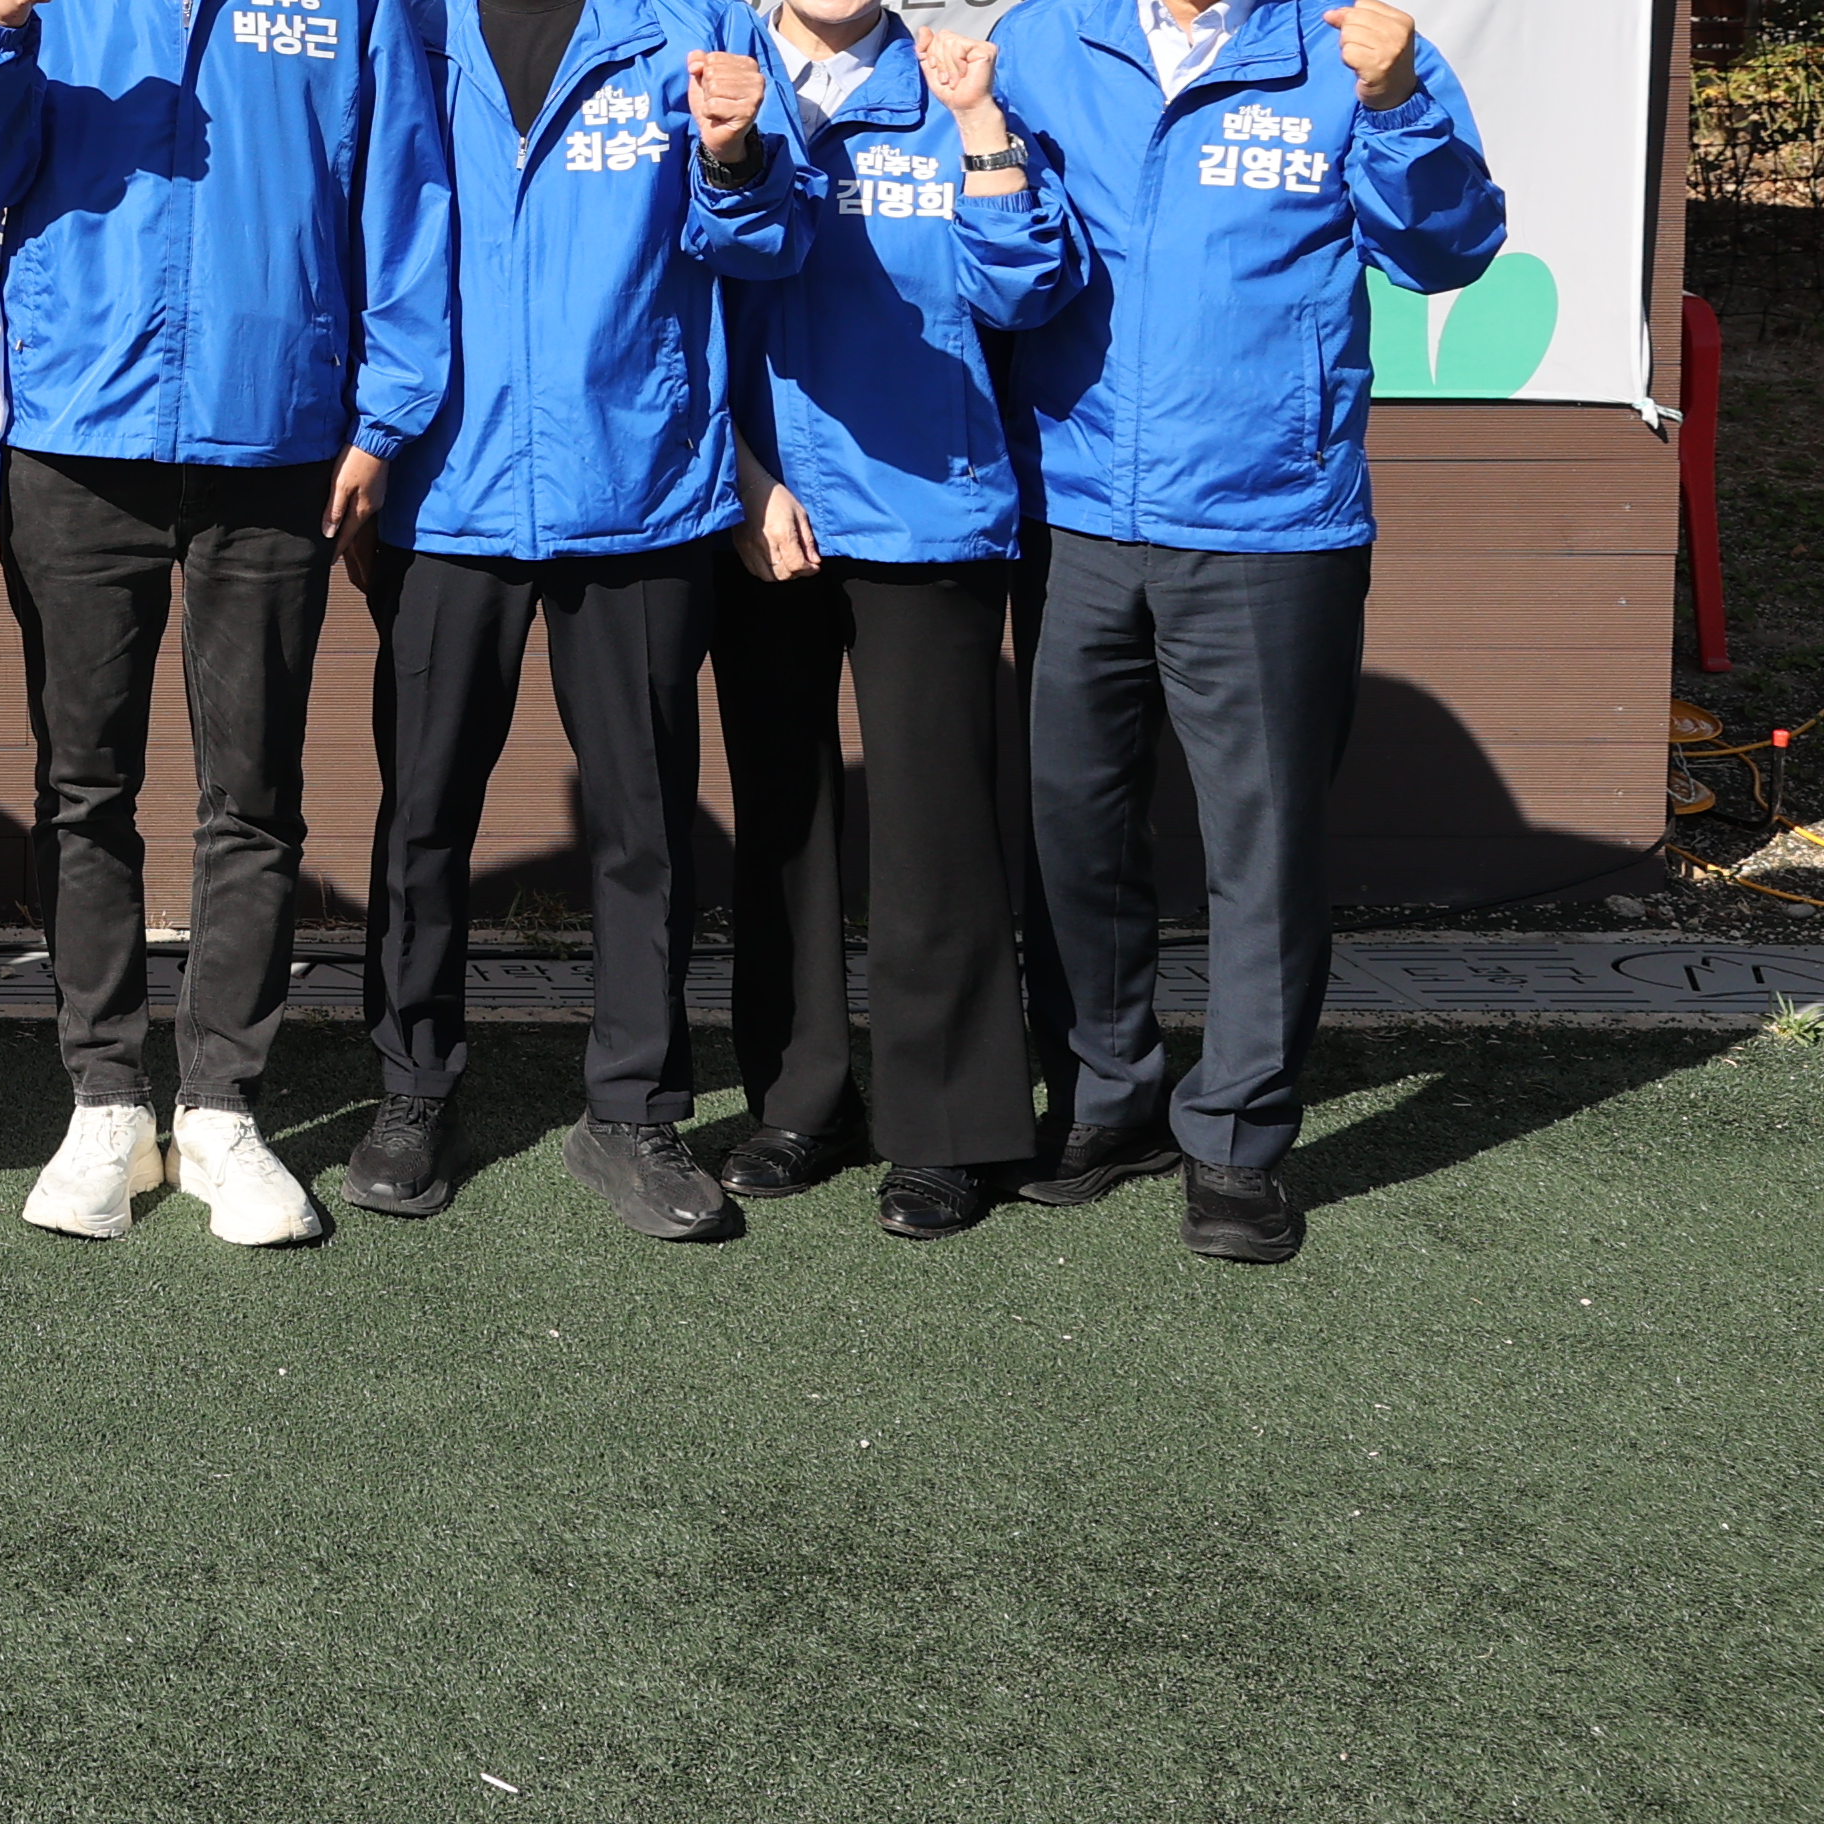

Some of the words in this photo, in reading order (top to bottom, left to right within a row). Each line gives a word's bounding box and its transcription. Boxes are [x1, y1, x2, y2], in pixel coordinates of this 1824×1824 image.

[233, 11, 338, 59] 박상근
[582, 96, 650, 126] 민주당
[1222, 113, 1313, 144] 민주당
[566, 121, 670, 172] 최승수
[856, 151, 940, 180] 민주당
[1198, 144, 1330, 194] 김영찬
[837, 179, 954, 220] 김명희
